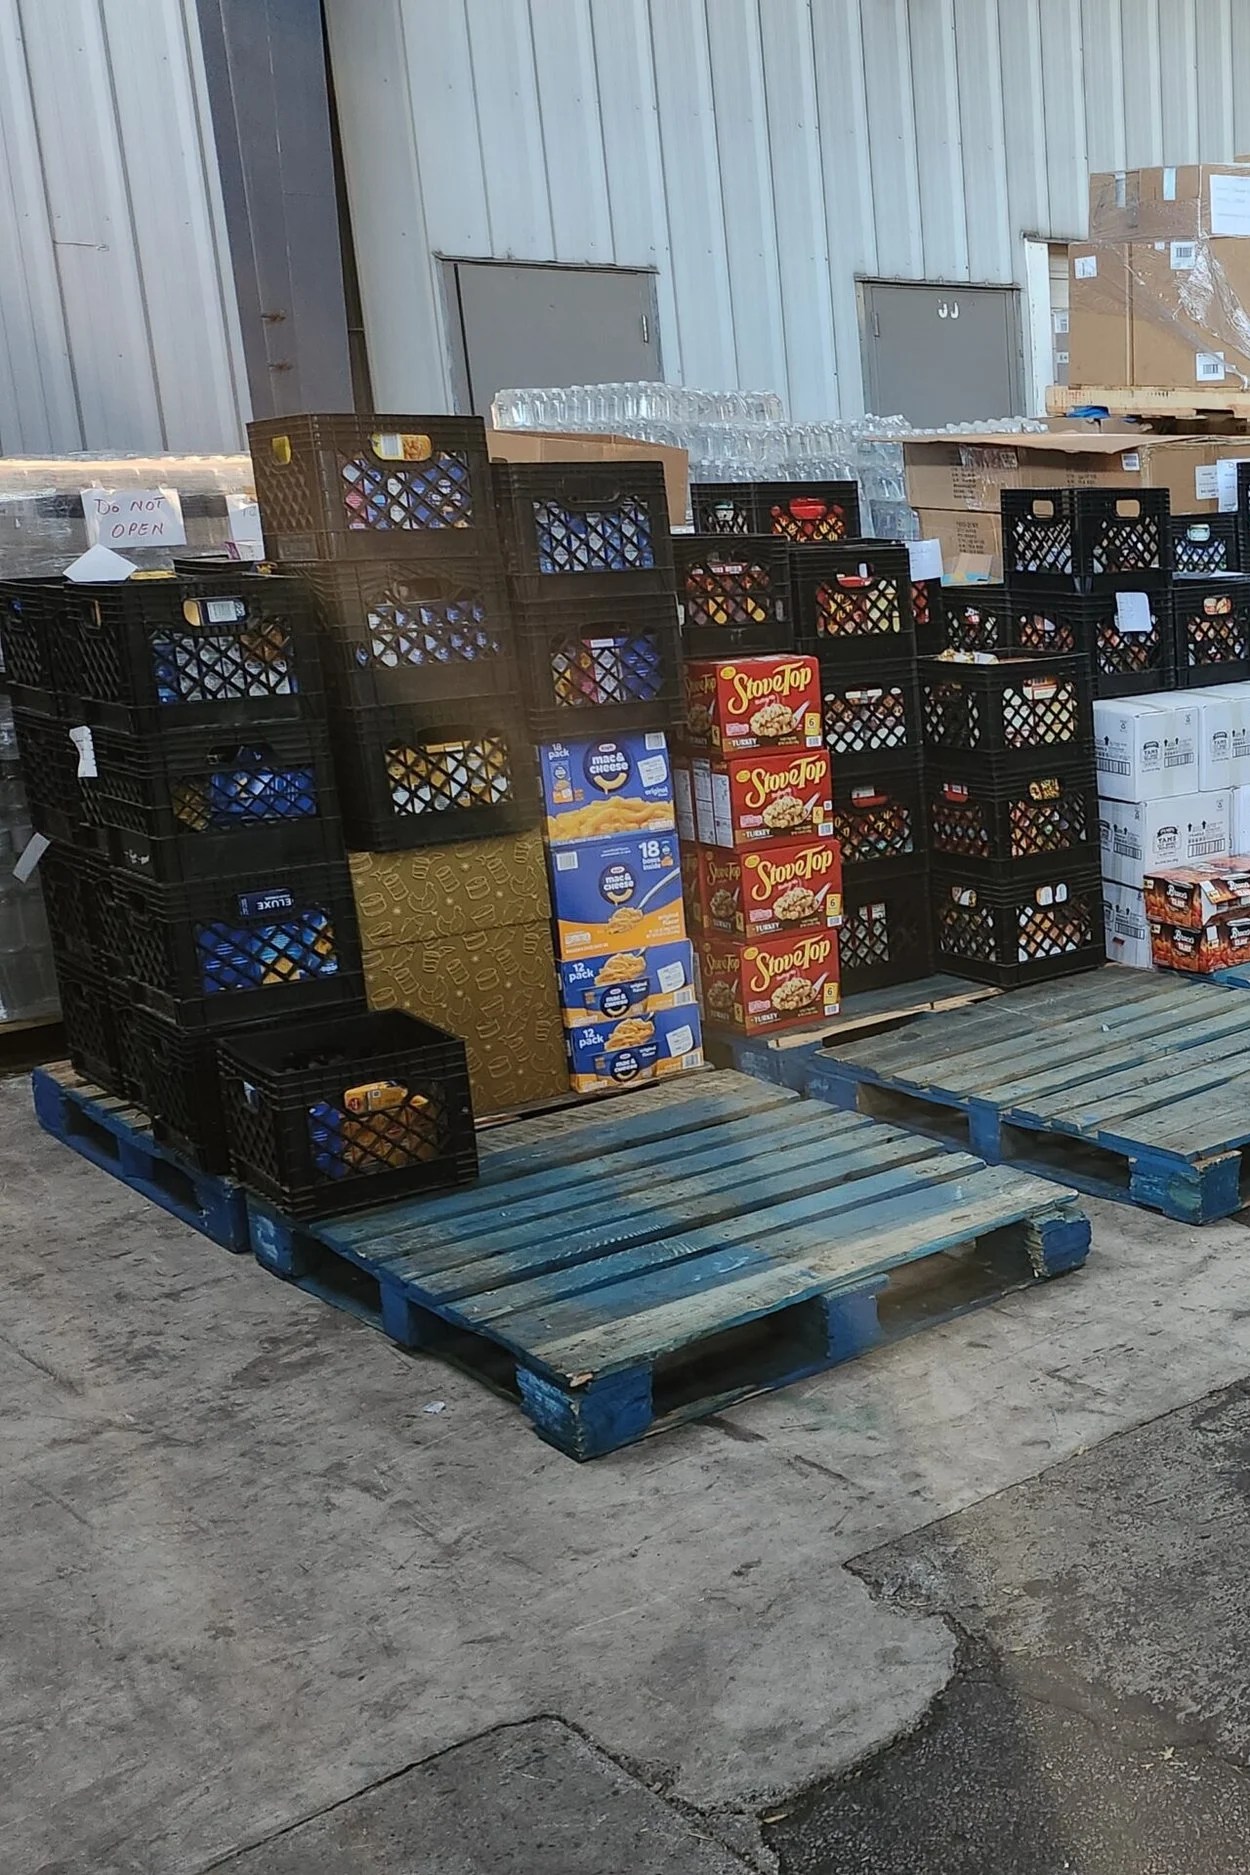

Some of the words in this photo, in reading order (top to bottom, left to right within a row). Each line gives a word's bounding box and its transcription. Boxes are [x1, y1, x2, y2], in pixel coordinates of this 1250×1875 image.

[93, 499, 120, 515] Do
[129, 496, 166, 512] NOT
[111, 522, 164, 539] OPEN
[552, 743, 562, 752] 18
[731, 738, 758, 747] TURKEY
[548, 749, 570, 760] pack
[644, 787, 669, 796] original
[745, 829, 771, 838] TURKEY
[638, 840, 660, 858] 18
[257, 898, 294, 910] ELUXE
[755, 922, 780, 932] TURKEY
[572, 963, 585, 973] 12
[569, 969, 595, 983] pack
[754, 1013, 778, 1022] TURKEY
[582, 1028, 595, 1038] 12
[579, 1034, 605, 1049] pack
